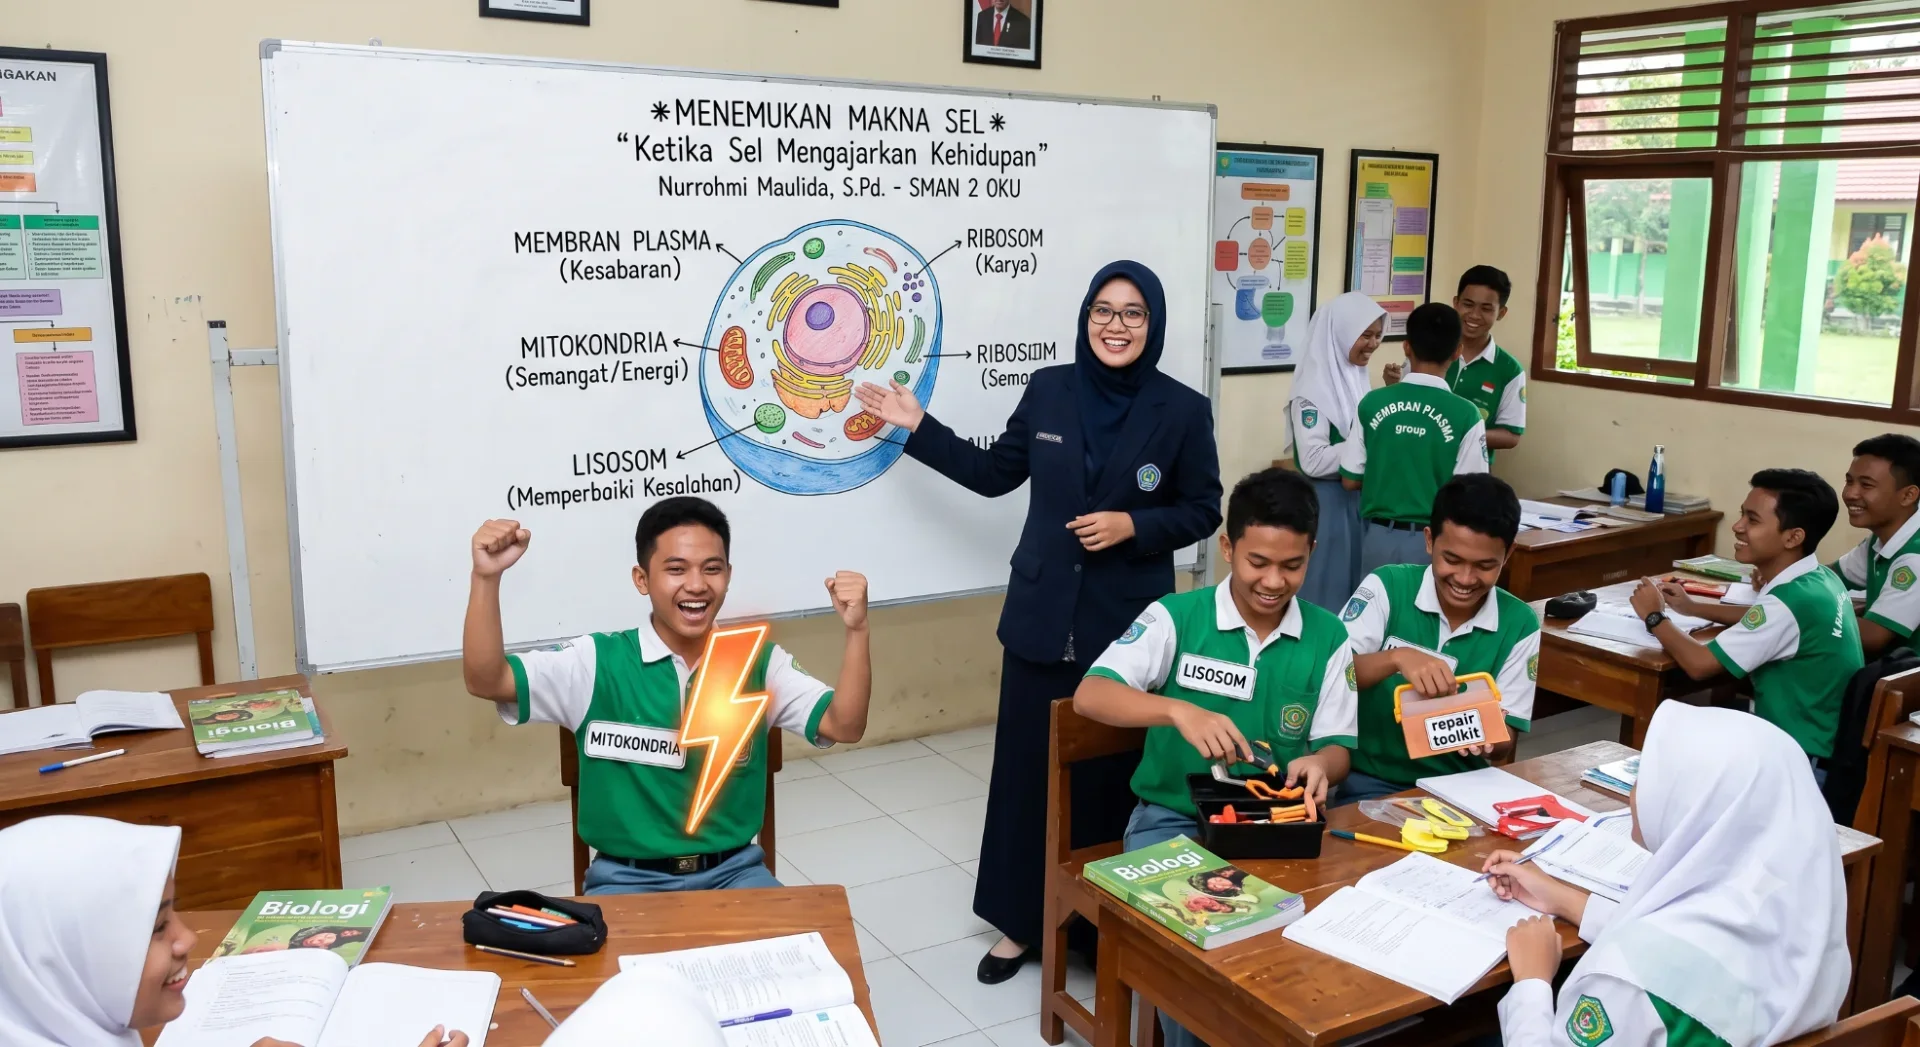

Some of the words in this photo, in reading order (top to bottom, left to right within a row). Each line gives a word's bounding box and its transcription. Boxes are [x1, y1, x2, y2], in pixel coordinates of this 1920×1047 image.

[0, 69, 57, 82] GAKAN
[848, 104, 930, 133] MAKNA
[729, 136, 762, 164] Sel
[777, 137, 917, 172] Mengajarkan
[658, 175, 748, 198] Nurrohmi
[757, 175, 834, 200] Maulida,
[843, 176, 885, 198] S.Pd.
[909, 176, 960, 199] SMAN
[968, 177, 979, 199] 2
[986, 177, 1021, 199] OKU
[514, 230, 621, 254] MEMBRAN
[633, 229, 712, 252] PLASMA
[967, 228, 1044, 249] RIBOSOM
[559, 256, 682, 284] (Kesabaran)
[975, 254, 1038, 278] (Karya)
[521, 332, 668, 359] MITOKONDRIA
[505, 356, 690, 392] (Semangat/Energi)
[1369, 401, 1422, 431] MEMBRAN
[1421, 404, 1455, 443] PLASMA
[1395, 424, 1427, 438] group
[573, 449, 667, 476] LISOSOM
[507, 478, 634, 511] (Memperbaiki
[642, 468, 741, 501] Kesalahan)
[1183, 663, 1247, 690] LISOSOM
[207, 719, 297, 739] Biologi
[1431, 713, 1475, 732] repair
[590, 730, 681, 757] MITOKONDRIA
[1432, 726, 1481, 747] toolkit
[1112, 848, 1205, 881] Biologi
[258, 900, 371, 919] Biologi
